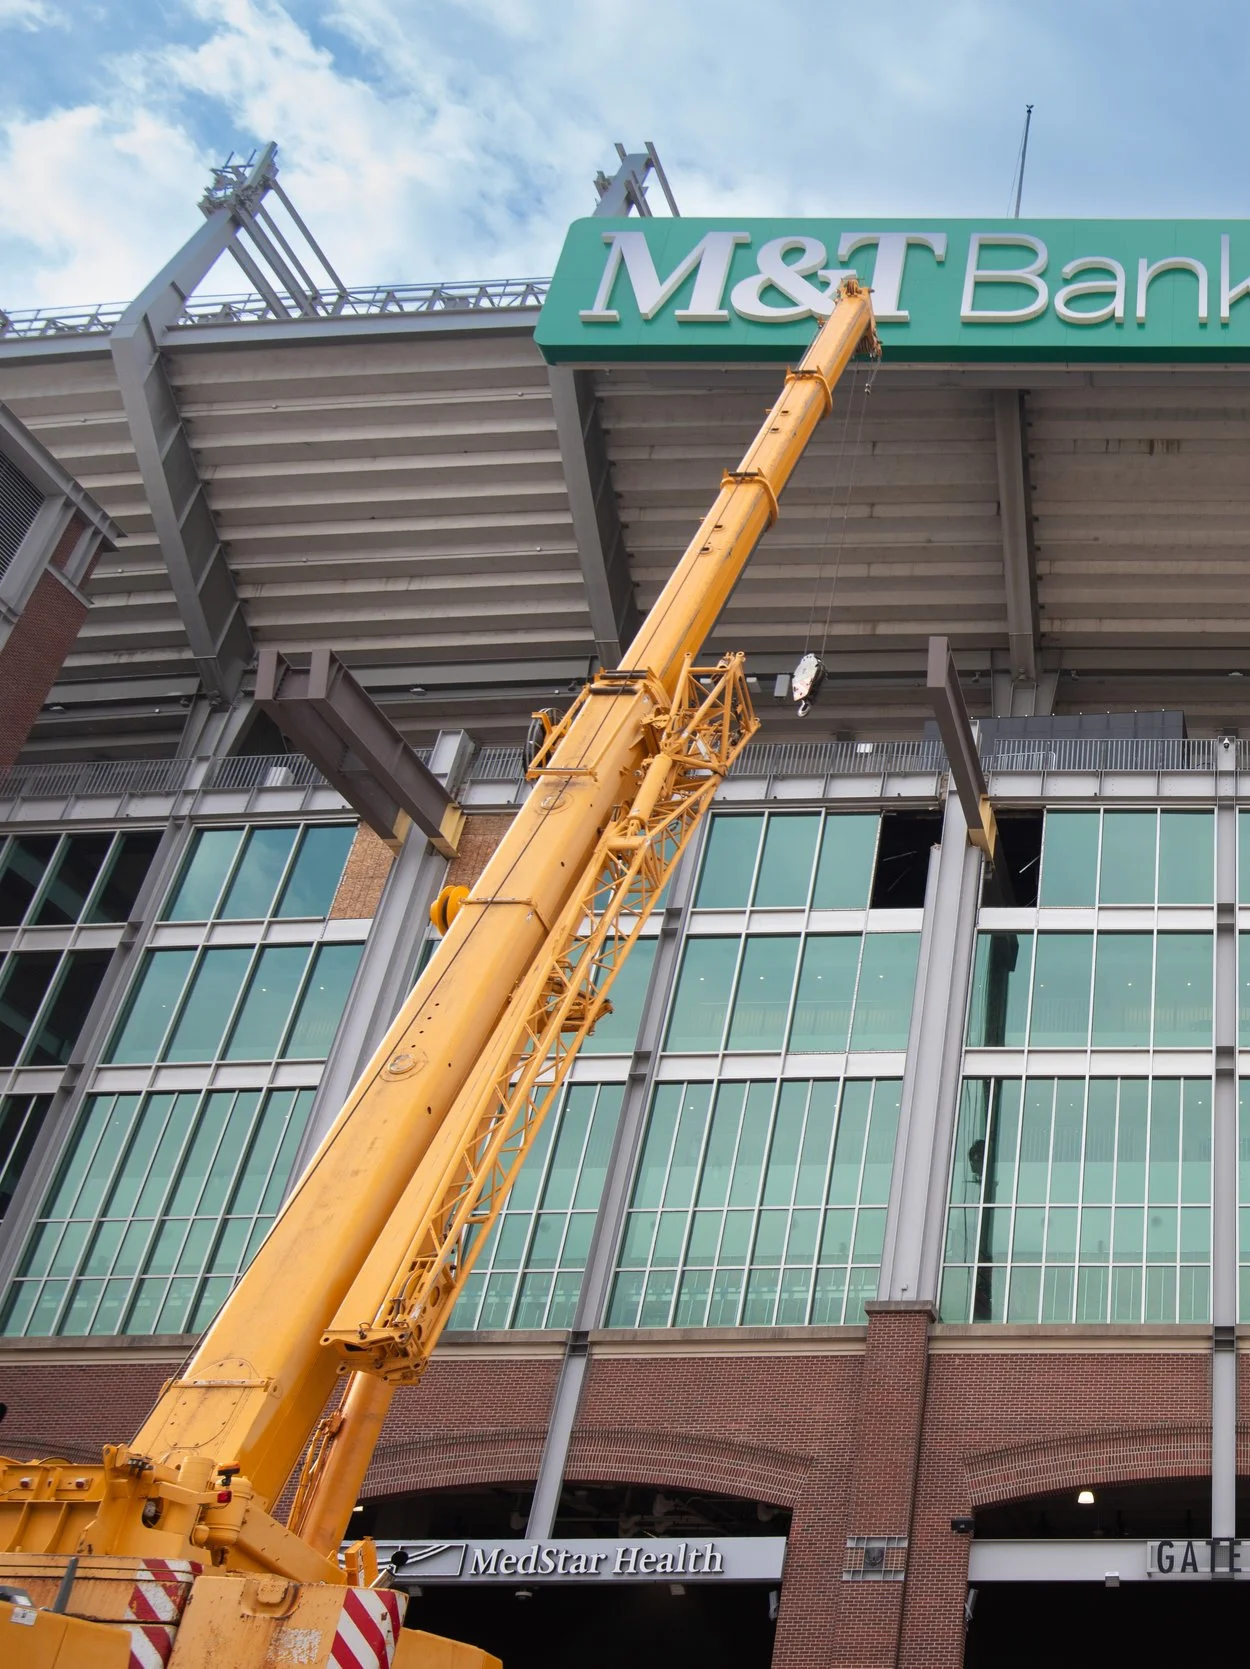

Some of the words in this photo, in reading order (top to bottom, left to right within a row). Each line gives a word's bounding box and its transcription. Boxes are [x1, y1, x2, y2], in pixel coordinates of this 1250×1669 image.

[578, 231, 946, 323] M&T
[469, 1545, 606, 1575] MedStar
[614, 1542, 724, 1574] Health
[1157, 1540, 1242, 1573] GATE
